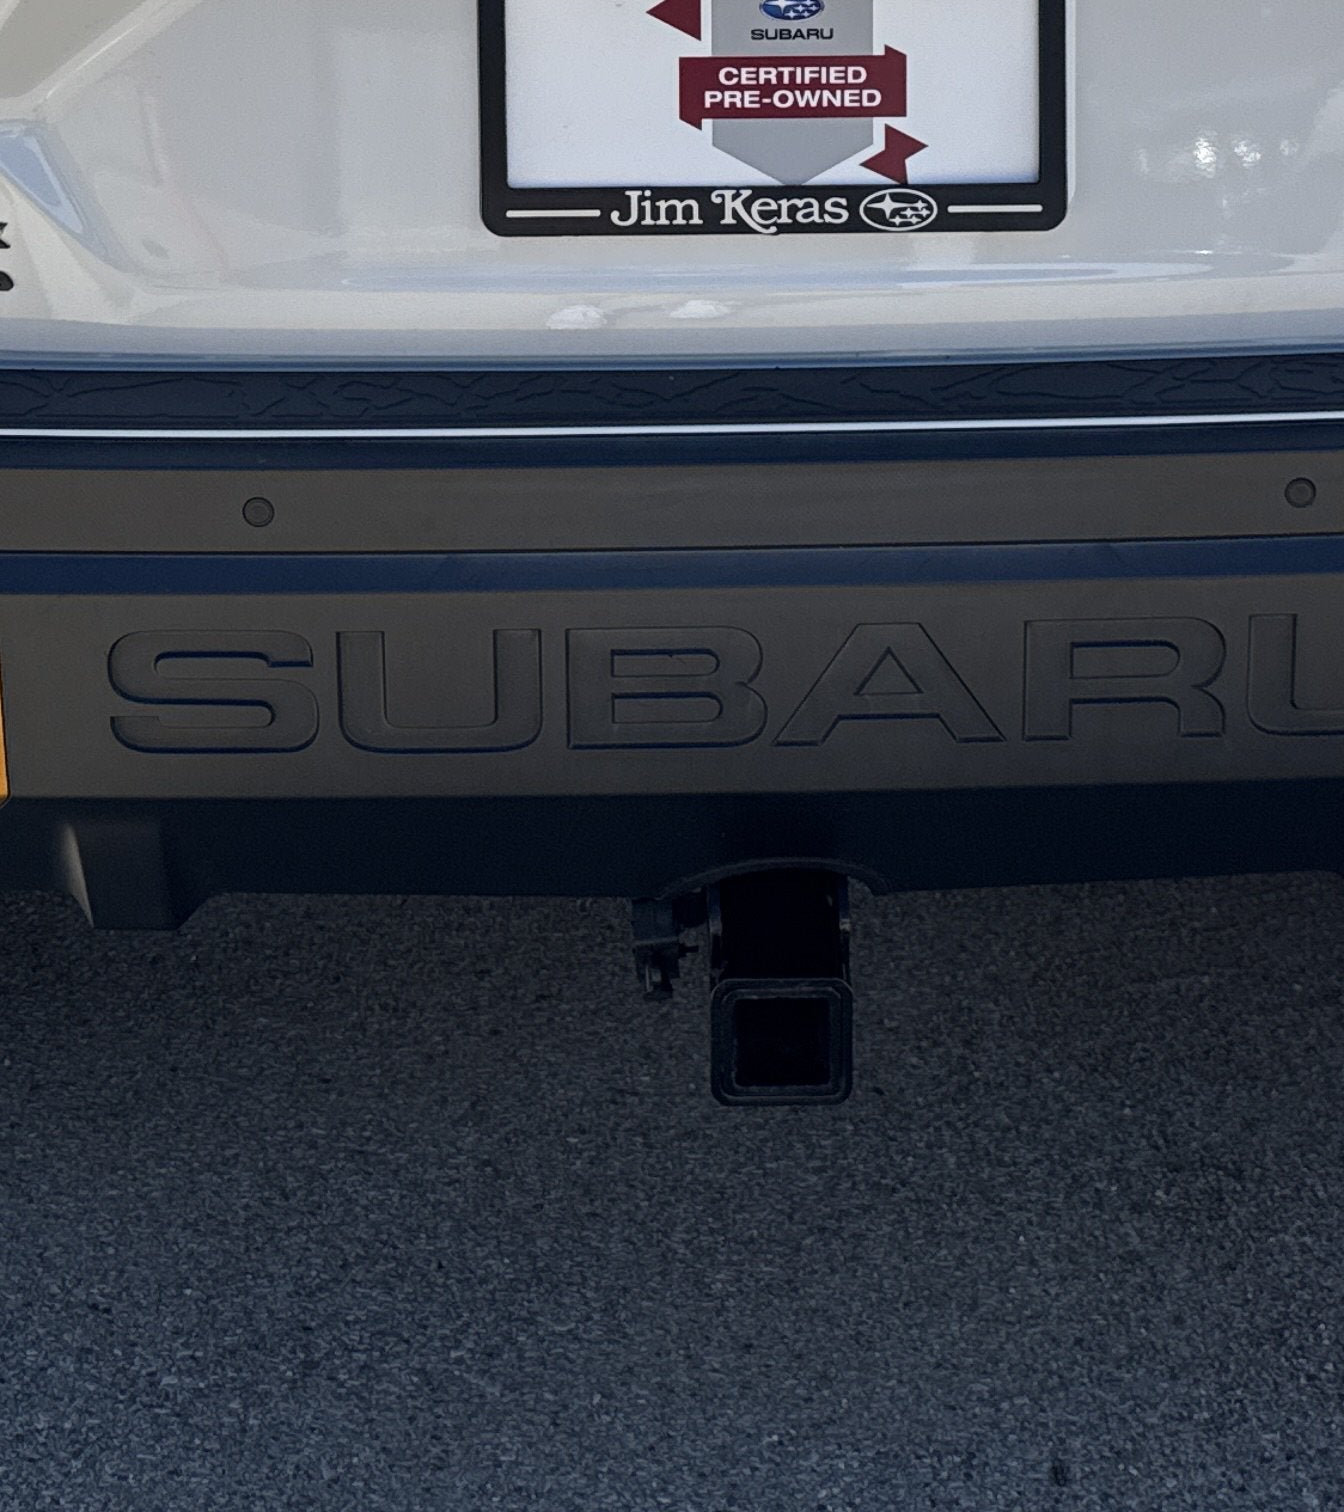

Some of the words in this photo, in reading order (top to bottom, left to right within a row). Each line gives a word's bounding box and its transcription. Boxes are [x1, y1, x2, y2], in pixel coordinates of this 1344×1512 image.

[750, 28, 834, 41] SUBARU
[718, 66, 868, 86] CERTIFIED
[704, 88, 882, 109] PRE-OWNED
[610, 191, 703, 226] Jim
[710, 189, 849, 234] Keras
